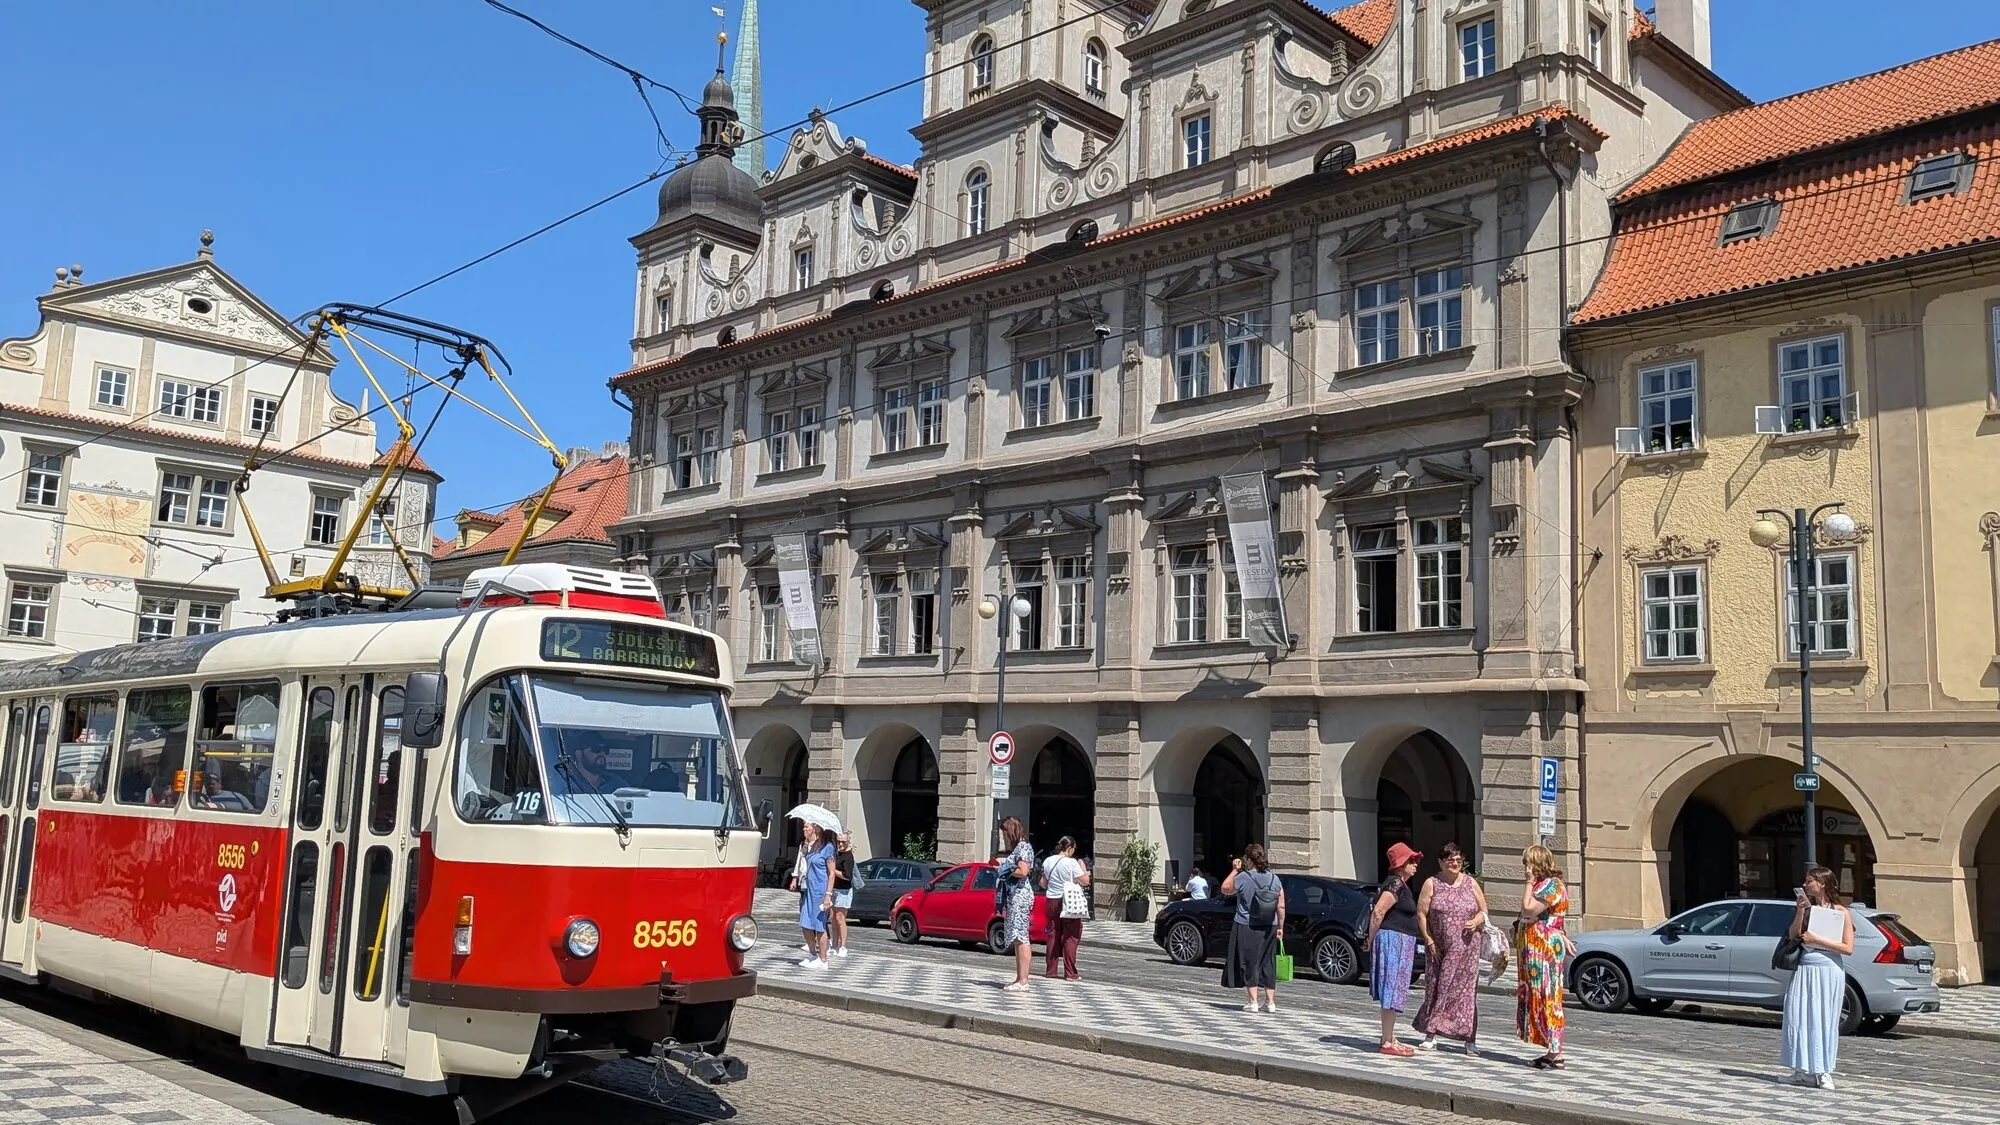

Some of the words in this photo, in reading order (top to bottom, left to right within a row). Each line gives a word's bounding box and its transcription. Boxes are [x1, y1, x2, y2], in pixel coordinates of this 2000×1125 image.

[1241, 568, 1272, 577] BESEDA
[546, 622, 582, 659] 12
[593, 647, 696, 670] BARRANDOV
[1805, 778, 1817, 787] WC
[515, 791, 541, 811] 116
[217, 843, 245, 870] 8556
[216, 928, 228, 945] pid
[633, 919, 698, 949] 8556
